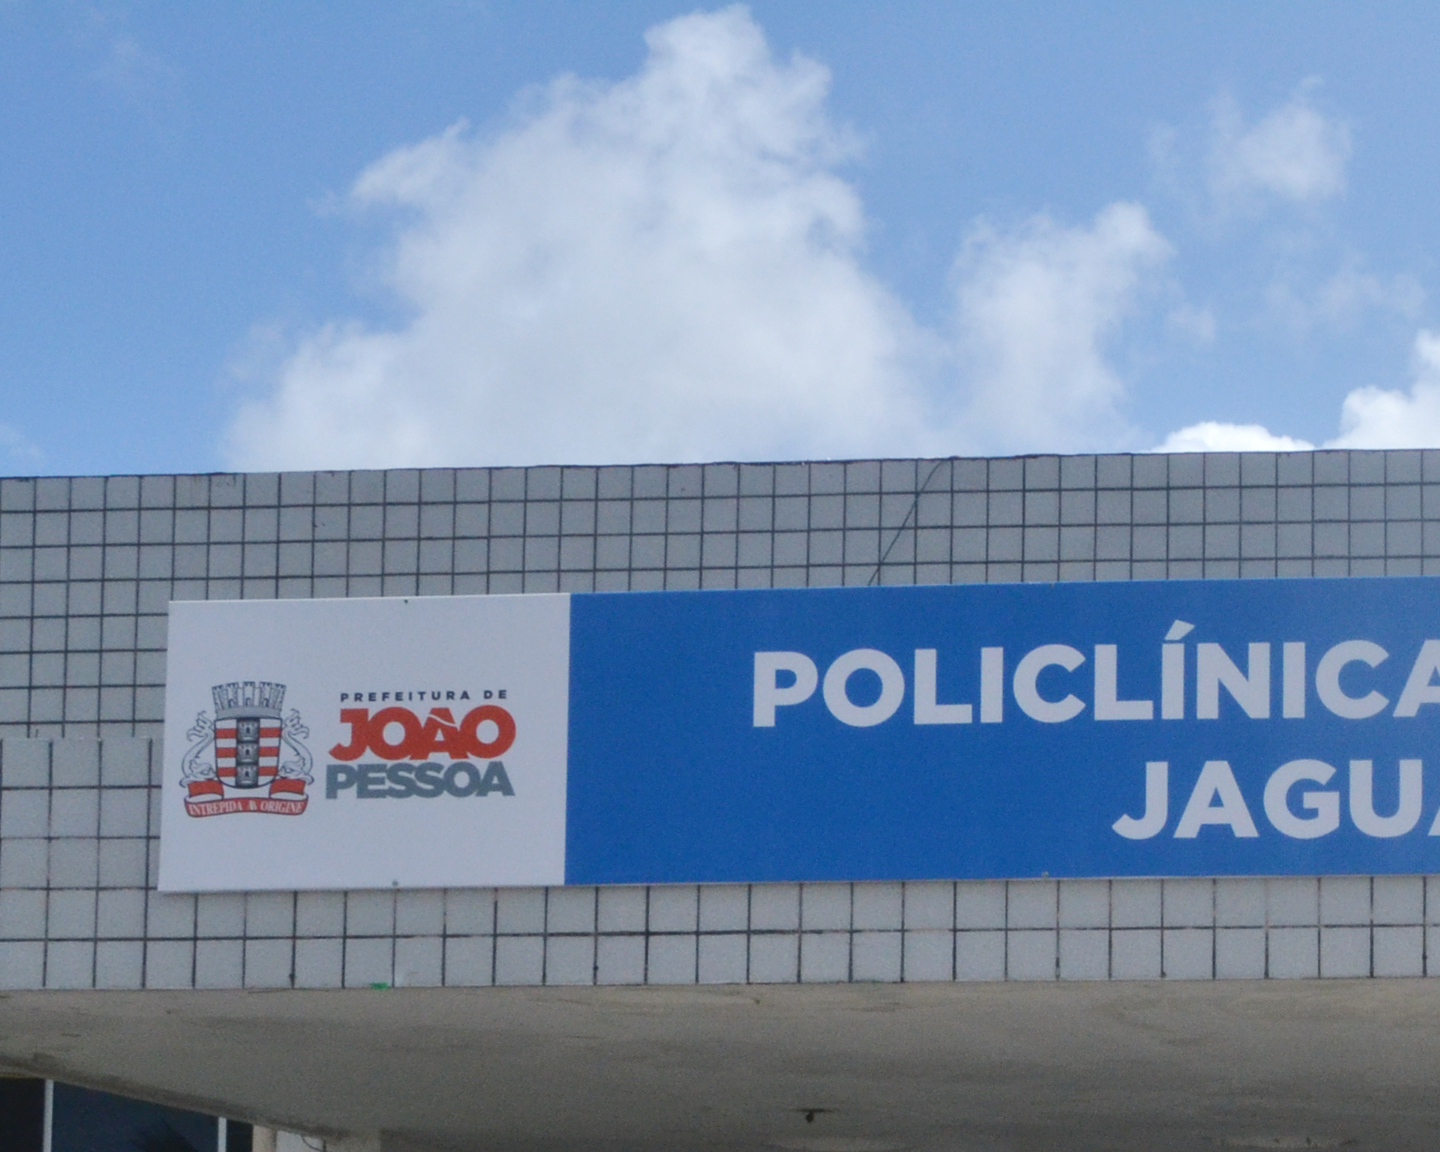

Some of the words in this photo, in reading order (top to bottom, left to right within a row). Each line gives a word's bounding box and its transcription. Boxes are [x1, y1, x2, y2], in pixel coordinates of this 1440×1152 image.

[340, 691, 471, 702] PREFEITURA
[483, 689, 508, 700] DE
[328, 704, 517, 761] JOÃO
[325, 761, 516, 799] PESSOA
